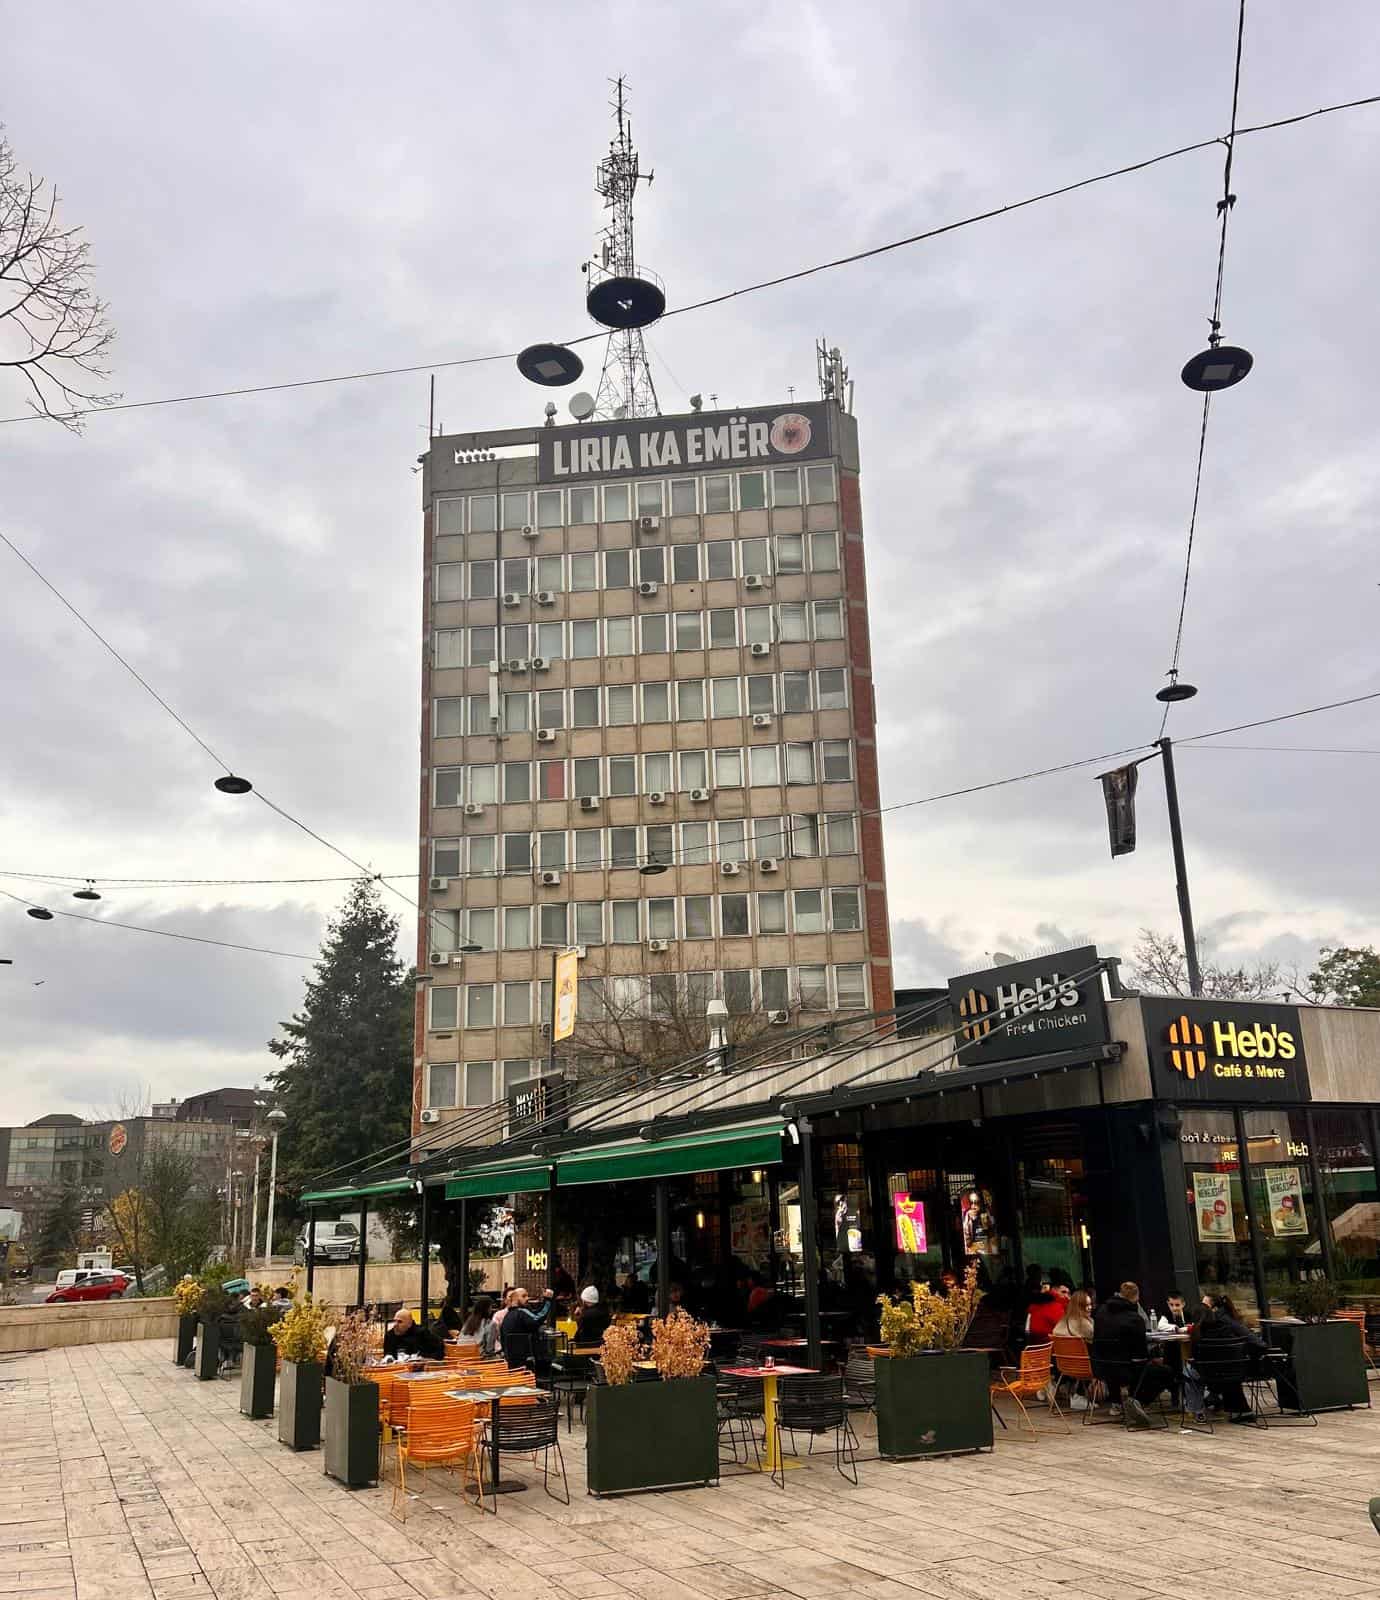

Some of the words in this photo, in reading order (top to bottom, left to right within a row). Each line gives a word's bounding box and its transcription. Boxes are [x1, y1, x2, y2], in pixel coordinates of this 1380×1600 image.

[553, 434, 633, 475] LIRIA
[639, 430, 682, 468] KA
[687, 416, 769, 464] EMËR
[996, 973, 1079, 1019] Heb's
[1006, 1021, 1035, 1037] Fried
[1038, 1013, 1087, 1031] Chicken
[1213, 1020, 1296, 1059] Heb's
[1214, 1063, 1242, 1078] Café
[1244, 1065, 1254, 1078] &
[1256, 1065, 1286, 1078] More
[526, 1248, 548, 1270] Heb
